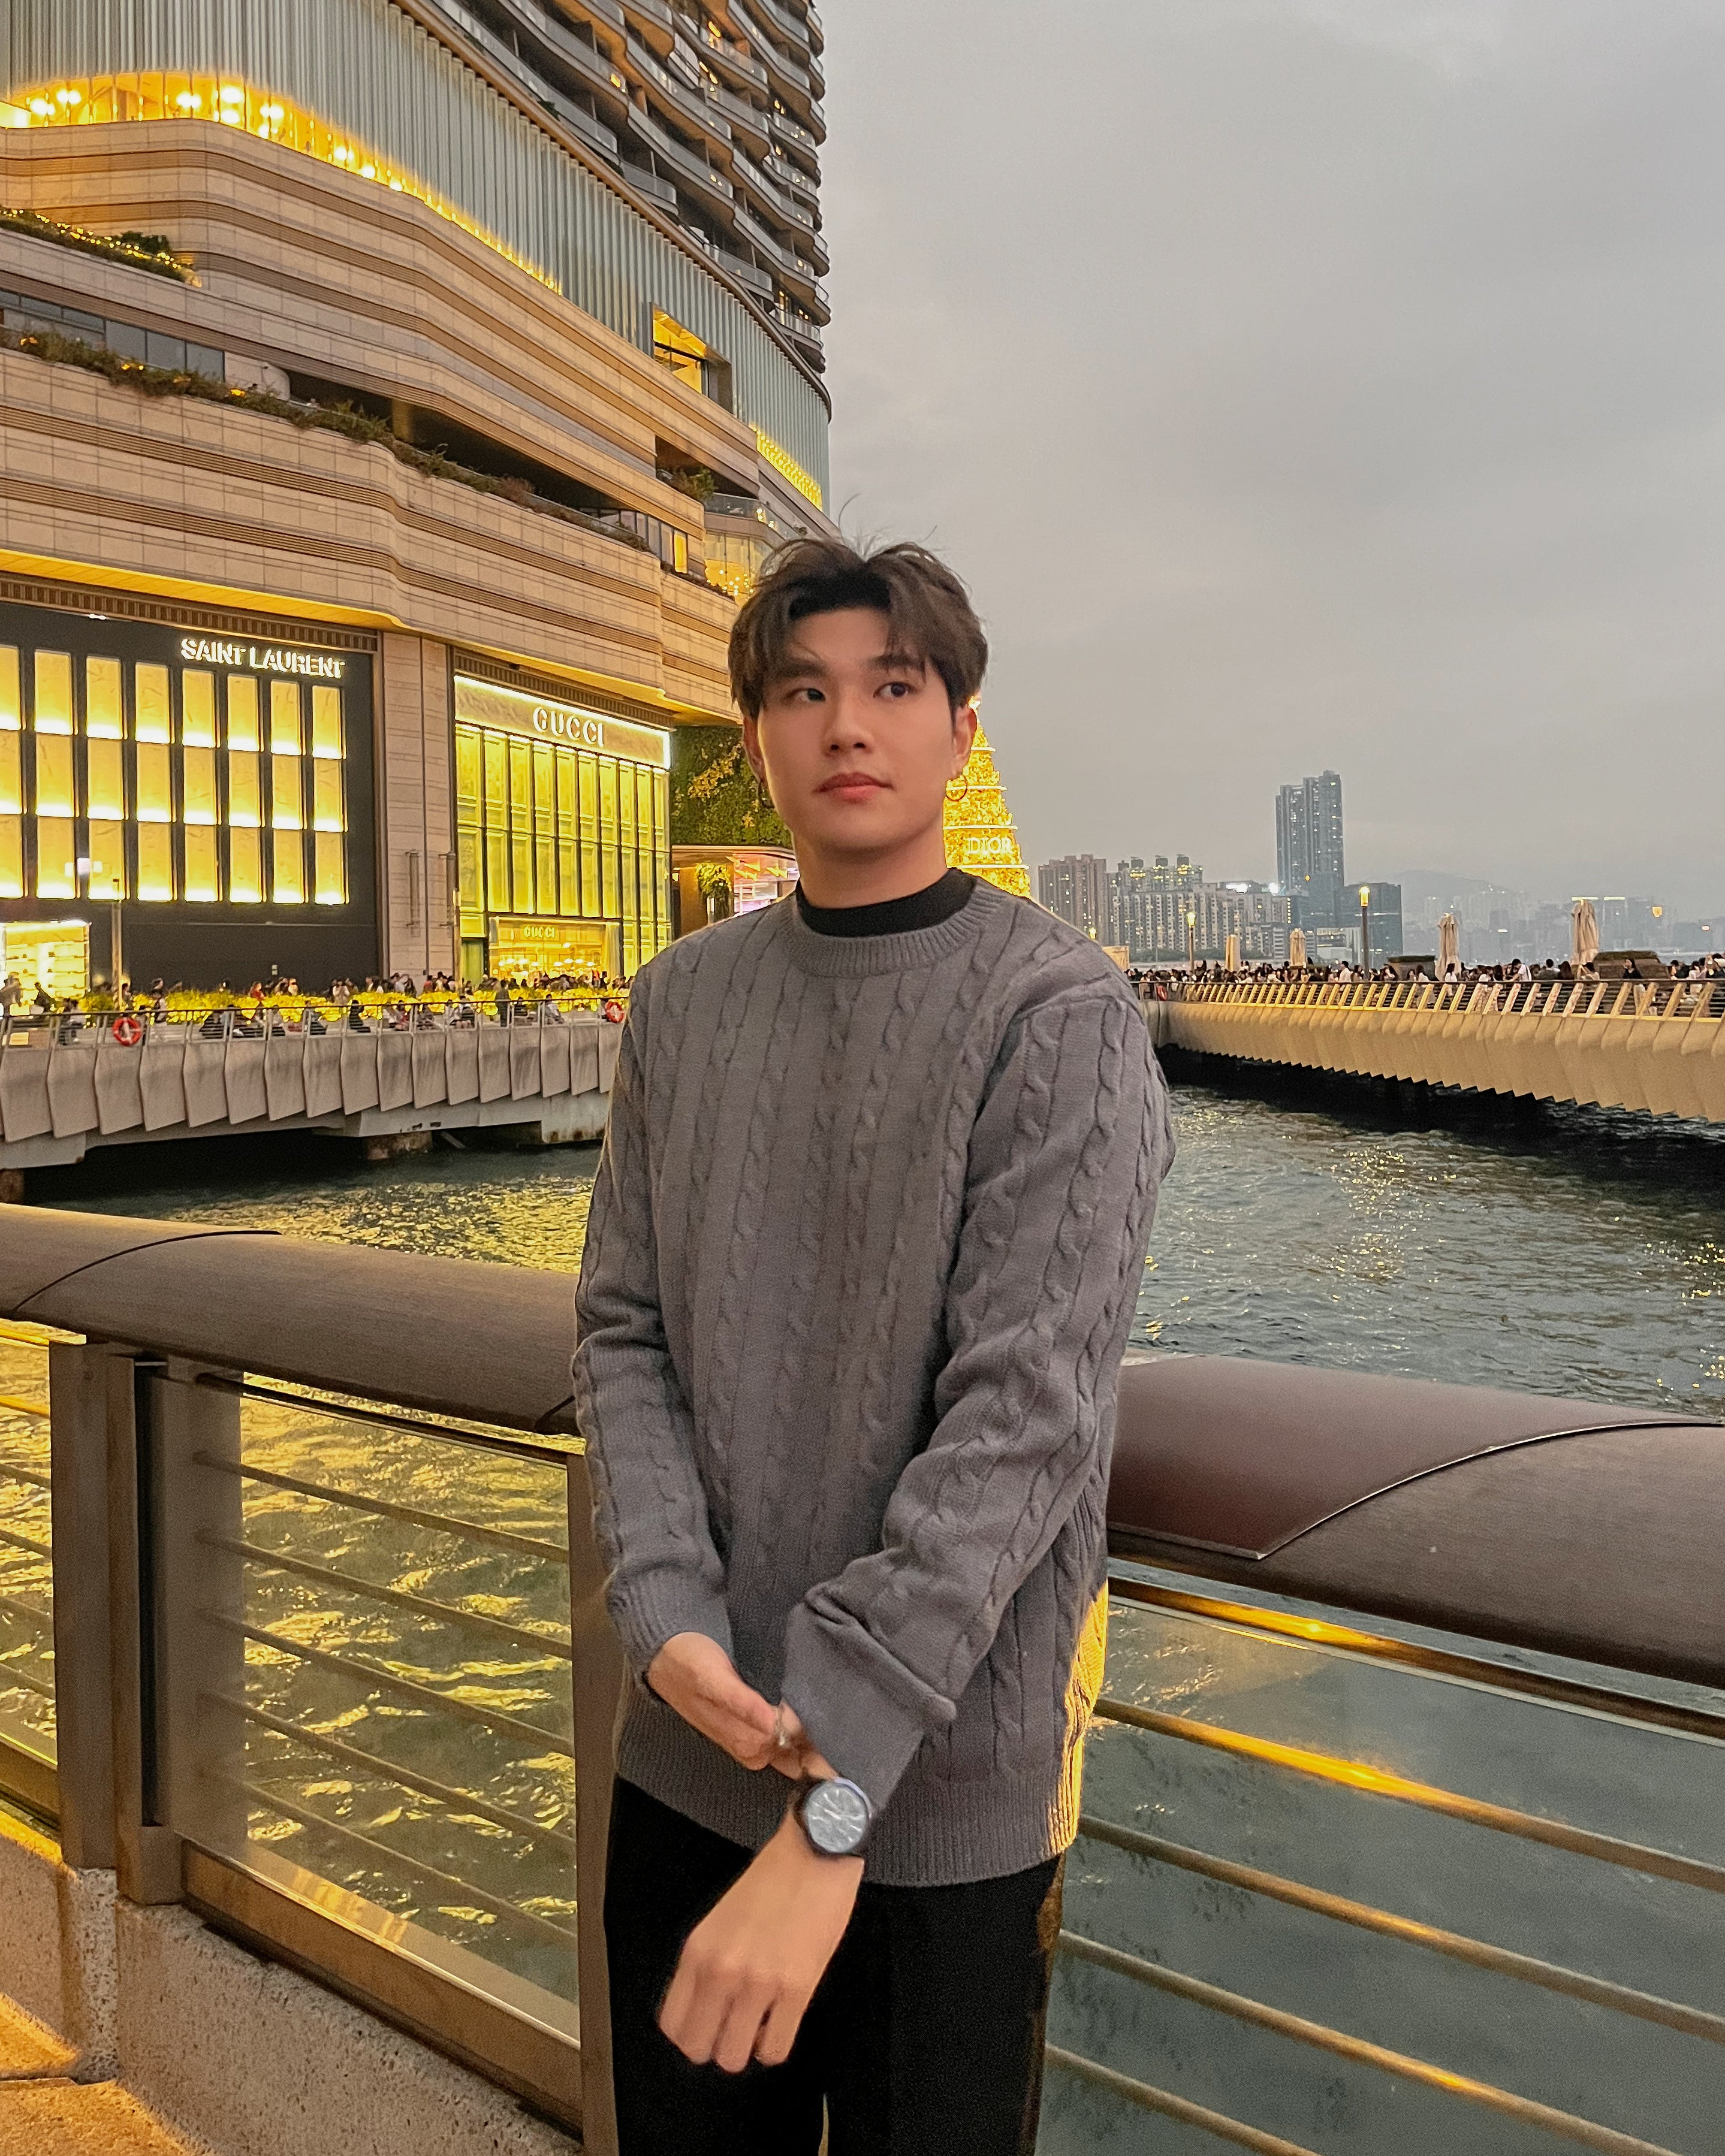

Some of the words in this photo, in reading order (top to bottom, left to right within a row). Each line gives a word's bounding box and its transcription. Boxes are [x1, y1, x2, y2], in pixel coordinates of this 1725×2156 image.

[181, 638, 246, 665] SAINT
[249, 647, 345, 678] LAURENT
[533, 706, 604, 748] GUCCI
[967, 837, 1012, 854] DIOR
[523, 925, 555, 938] GUCCI
